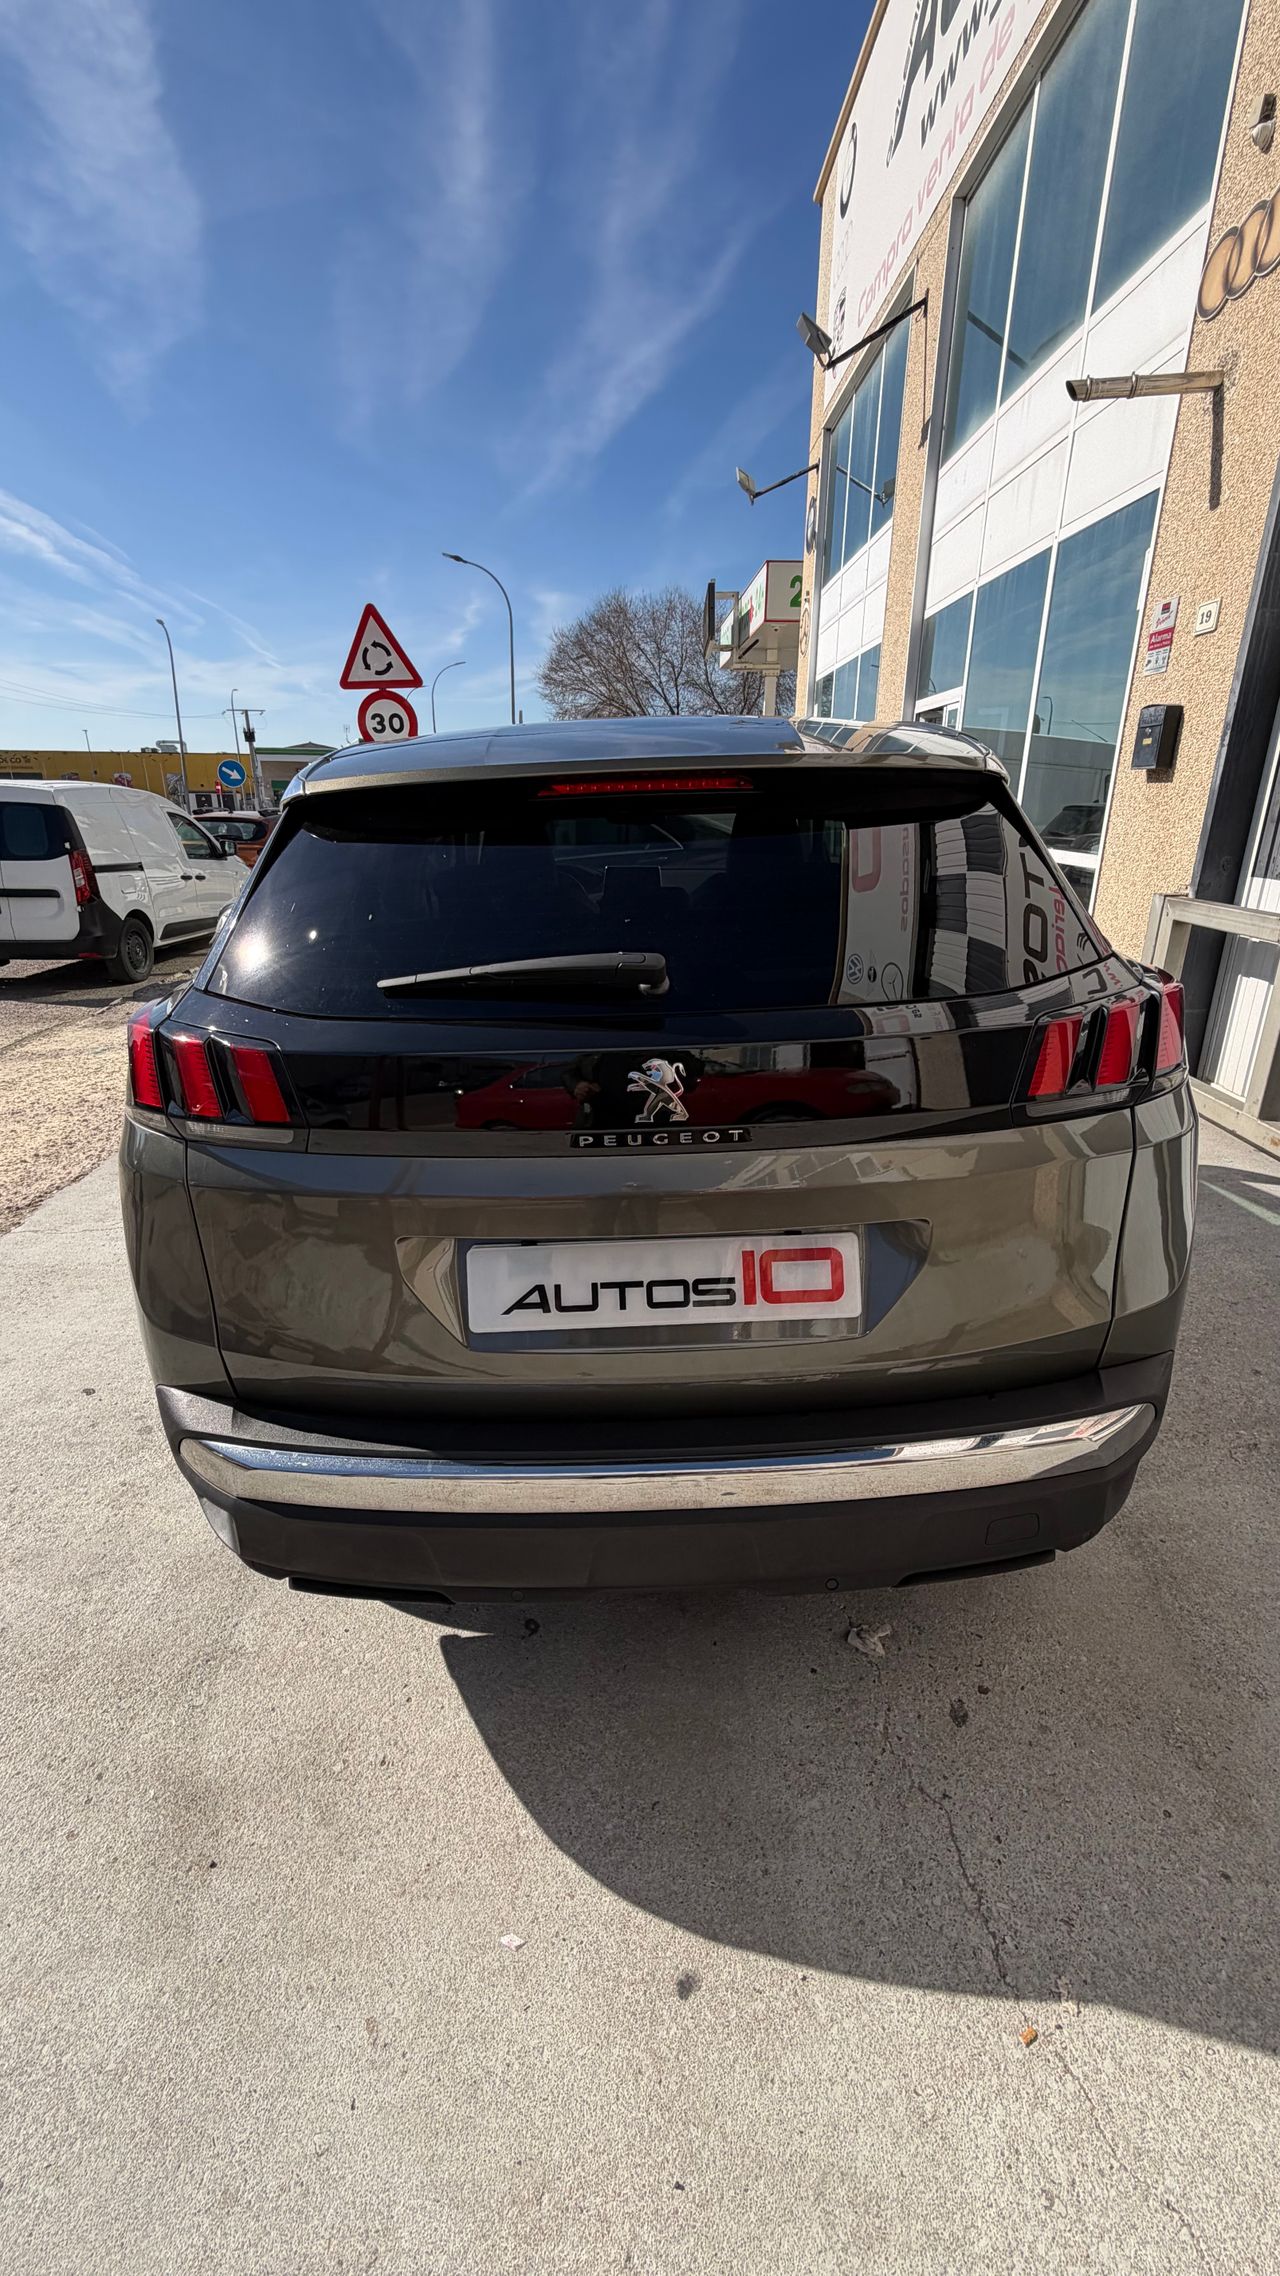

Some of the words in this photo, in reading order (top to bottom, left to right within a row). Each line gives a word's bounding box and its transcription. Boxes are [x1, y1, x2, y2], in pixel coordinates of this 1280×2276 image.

[918, 82, 975, 215] venta
[979, 4, 1015, 94] de
[1199, 609, 1213, 626] 19
[1150, 631, 1172, 645] Alarma
[370, 712, 405, 735] 30
[578, 1128, 745, 1148] PEUGEOT
[500, 1246, 844, 1316] AUTOS10
